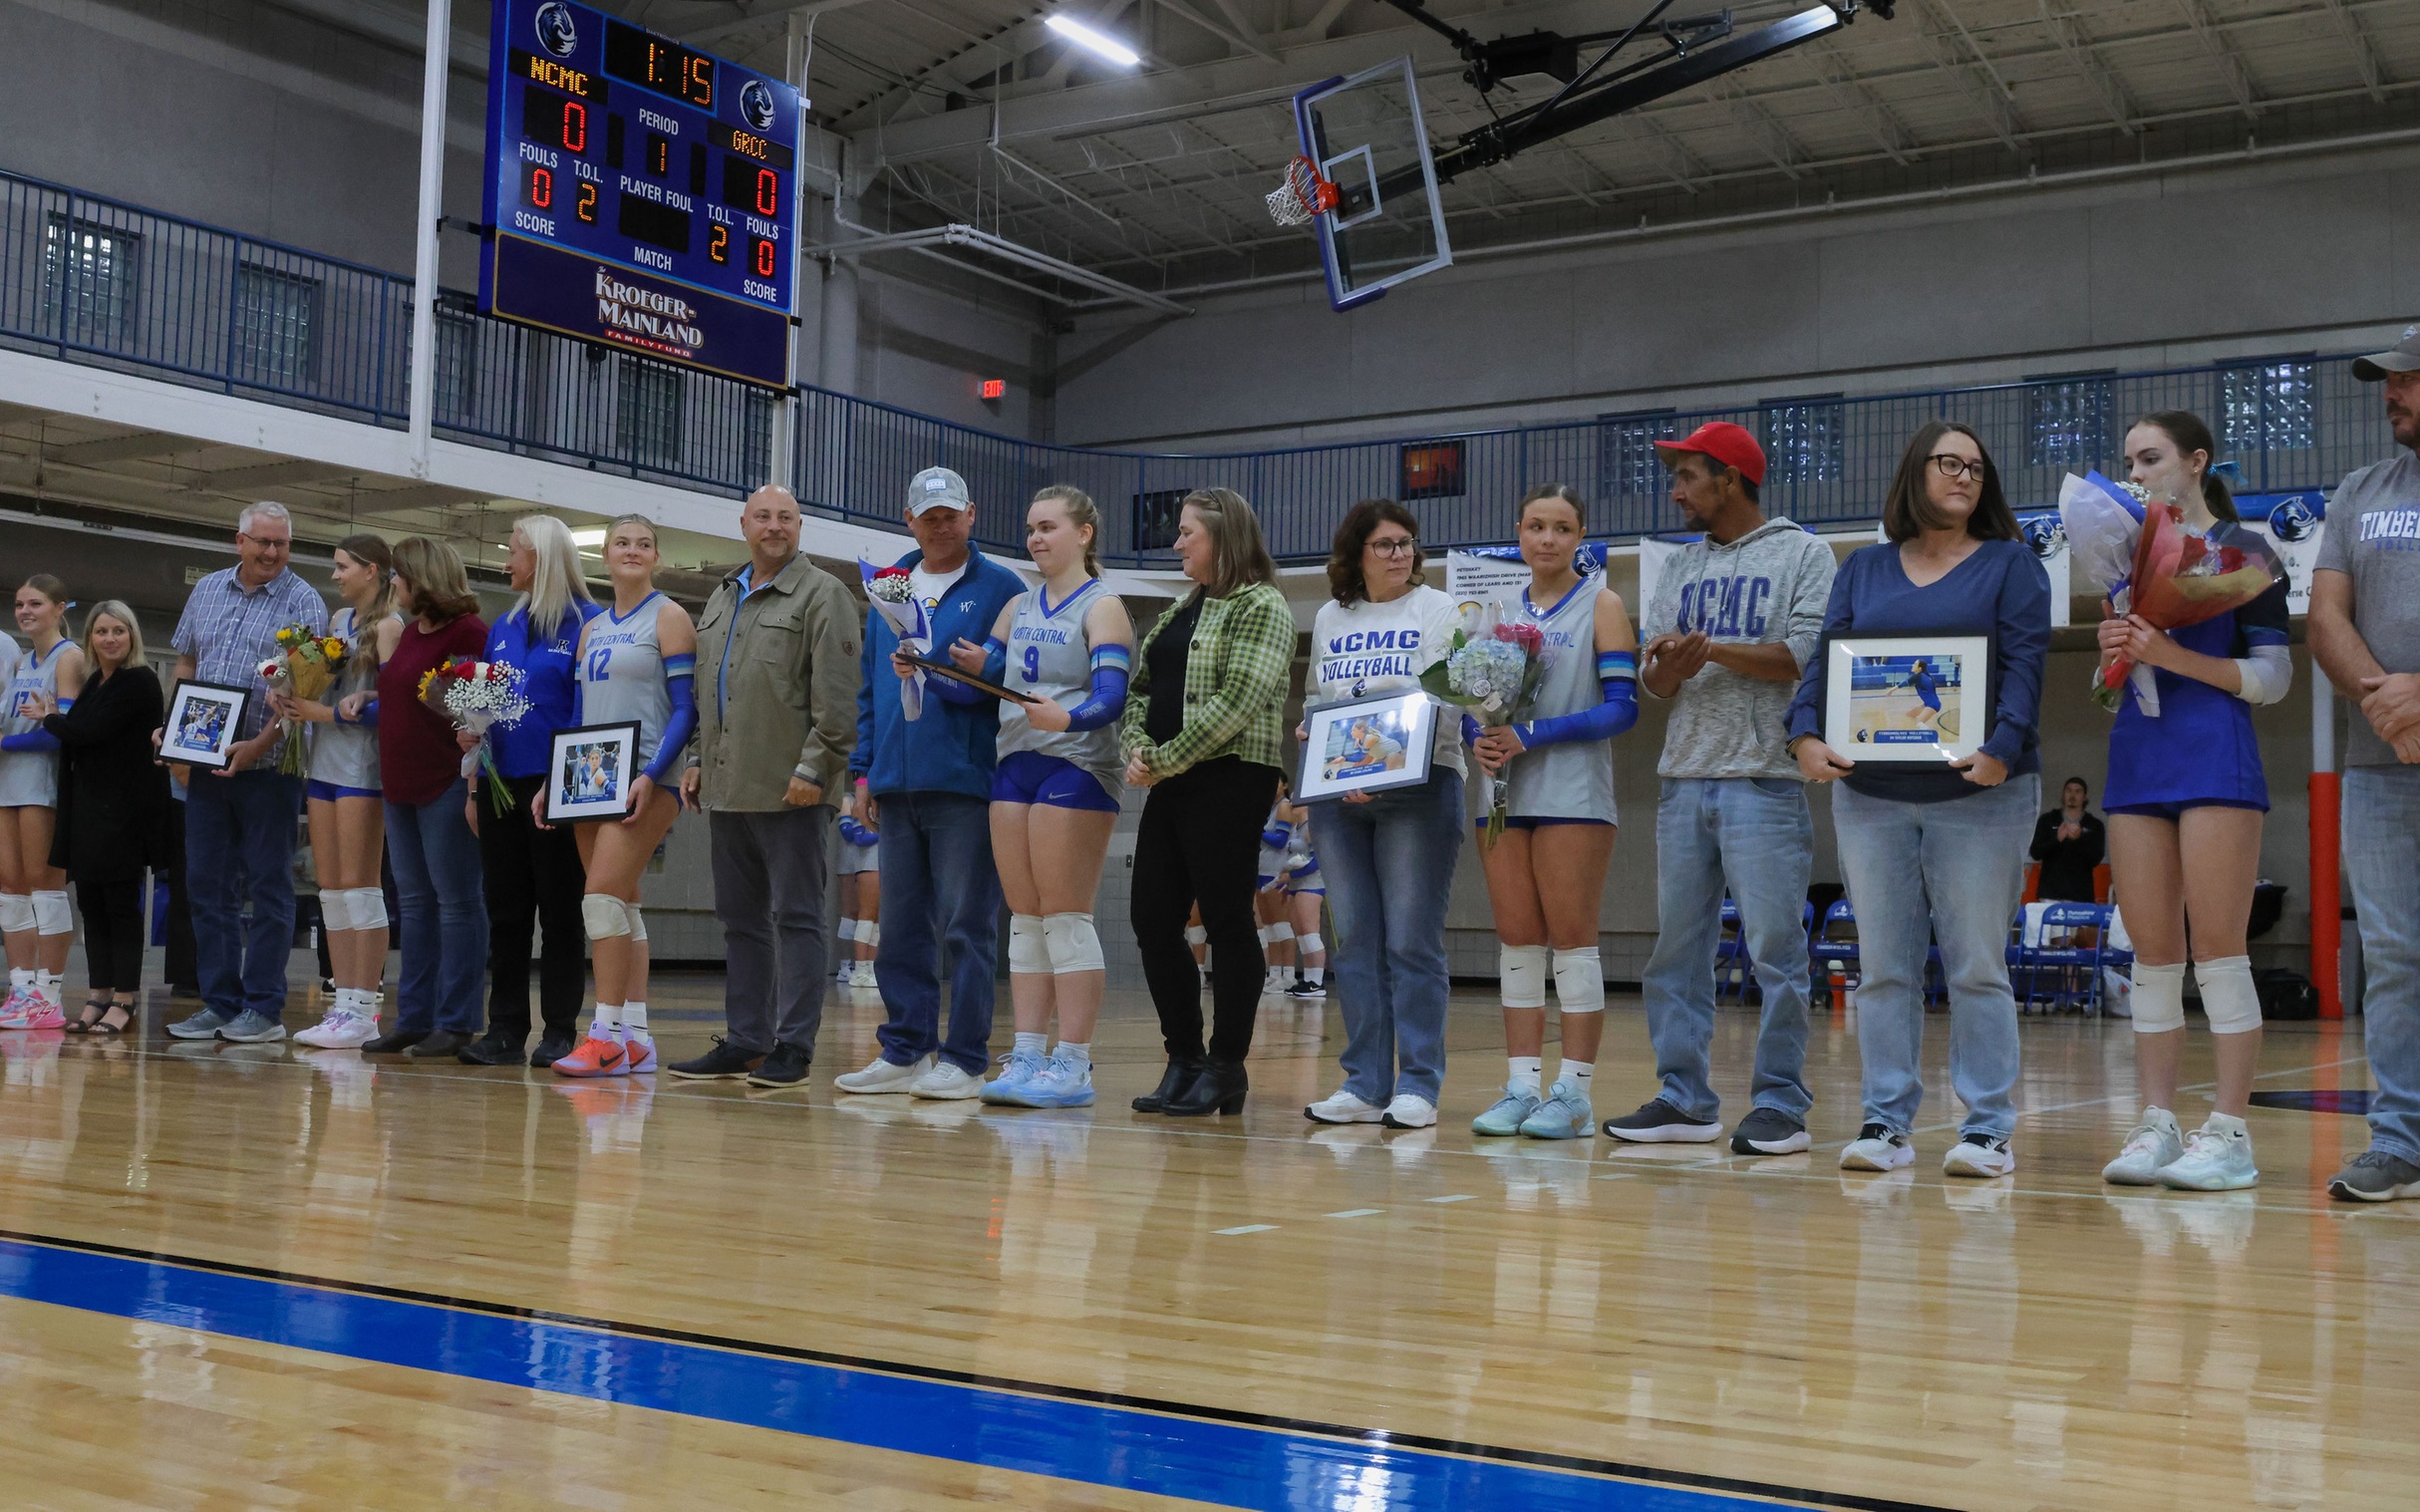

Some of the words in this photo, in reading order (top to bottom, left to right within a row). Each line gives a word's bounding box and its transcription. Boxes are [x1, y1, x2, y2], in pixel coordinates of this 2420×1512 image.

[530, 56, 588, 97] NCMC
[648, 42, 711, 105] 1:15
[563, 101, 586, 151] 0
[638, 108, 680, 136] PERIOD
[519, 142, 558, 168] FOULS
[660, 143, 666, 171] 1
[732, 130, 767, 159] GRCC
[573, 159, 604, 183] T.O.L.
[532, 168, 551, 207] 0
[620, 175, 662, 202] PLAYER
[666, 190, 694, 213] FOUL
[756, 169, 776, 216] 0
[578, 183, 596, 221] 2
[708, 204, 735, 226] T.O.L.
[515, 211, 555, 237] SCORE
[747, 217, 779, 239] FOULS
[711, 225, 727, 262] 2
[634, 246, 672, 271] MATCH
[757, 239, 773, 277] 0
[744, 279, 777, 303] SCORE
[599, 299, 704, 347] MAINLAND
[608, 330, 654, 348] FAMILY
[657, 344, 690, 357] FUND
[556, 639, 570, 652] K
[602, 633, 636, 646] CENTRAL
[1031, 628, 1067, 645] CENTRAL
[1326, 630, 1420, 654] NCMC
[588, 647, 613, 682] 12
[1022, 645, 1040, 684] 9
[1323, 656, 1413, 683] VOLLEYBALL
[10, 691, 30, 719] 17
